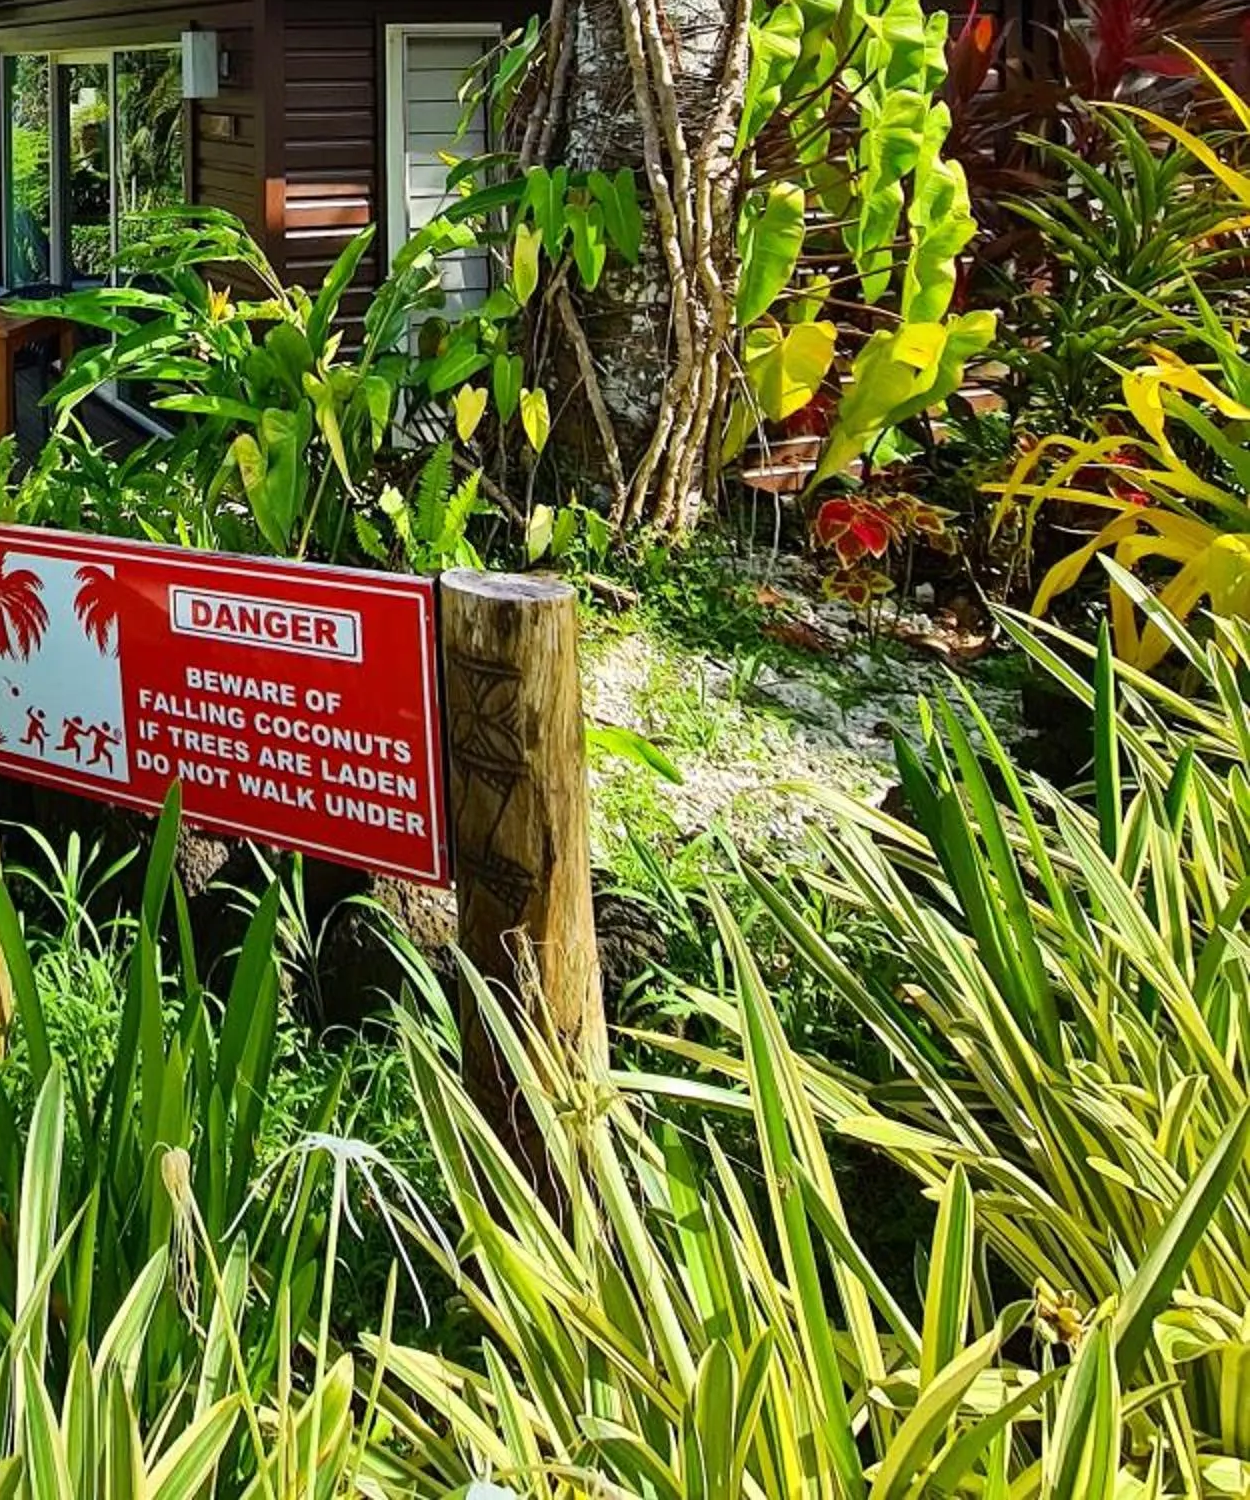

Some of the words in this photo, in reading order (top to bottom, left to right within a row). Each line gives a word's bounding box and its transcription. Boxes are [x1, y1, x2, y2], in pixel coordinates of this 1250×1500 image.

[190, 599, 339, 648] DANGER
[139, 689, 246, 730] FALLING
[254, 712, 412, 764] COCONUTS
[185, 666, 296, 708] BEWARE
[305, 689, 342, 715] OF
[136, 749, 171, 776] DO
[177, 759, 231, 789] NOT
[238, 774, 316, 811] WALK
[325, 796, 425, 837] UNDER
[138, 720, 160, 743] IF
[168, 726, 250, 763] TREES
[258, 746, 312, 777] ARE
[321, 760, 417, 801] LADEN
